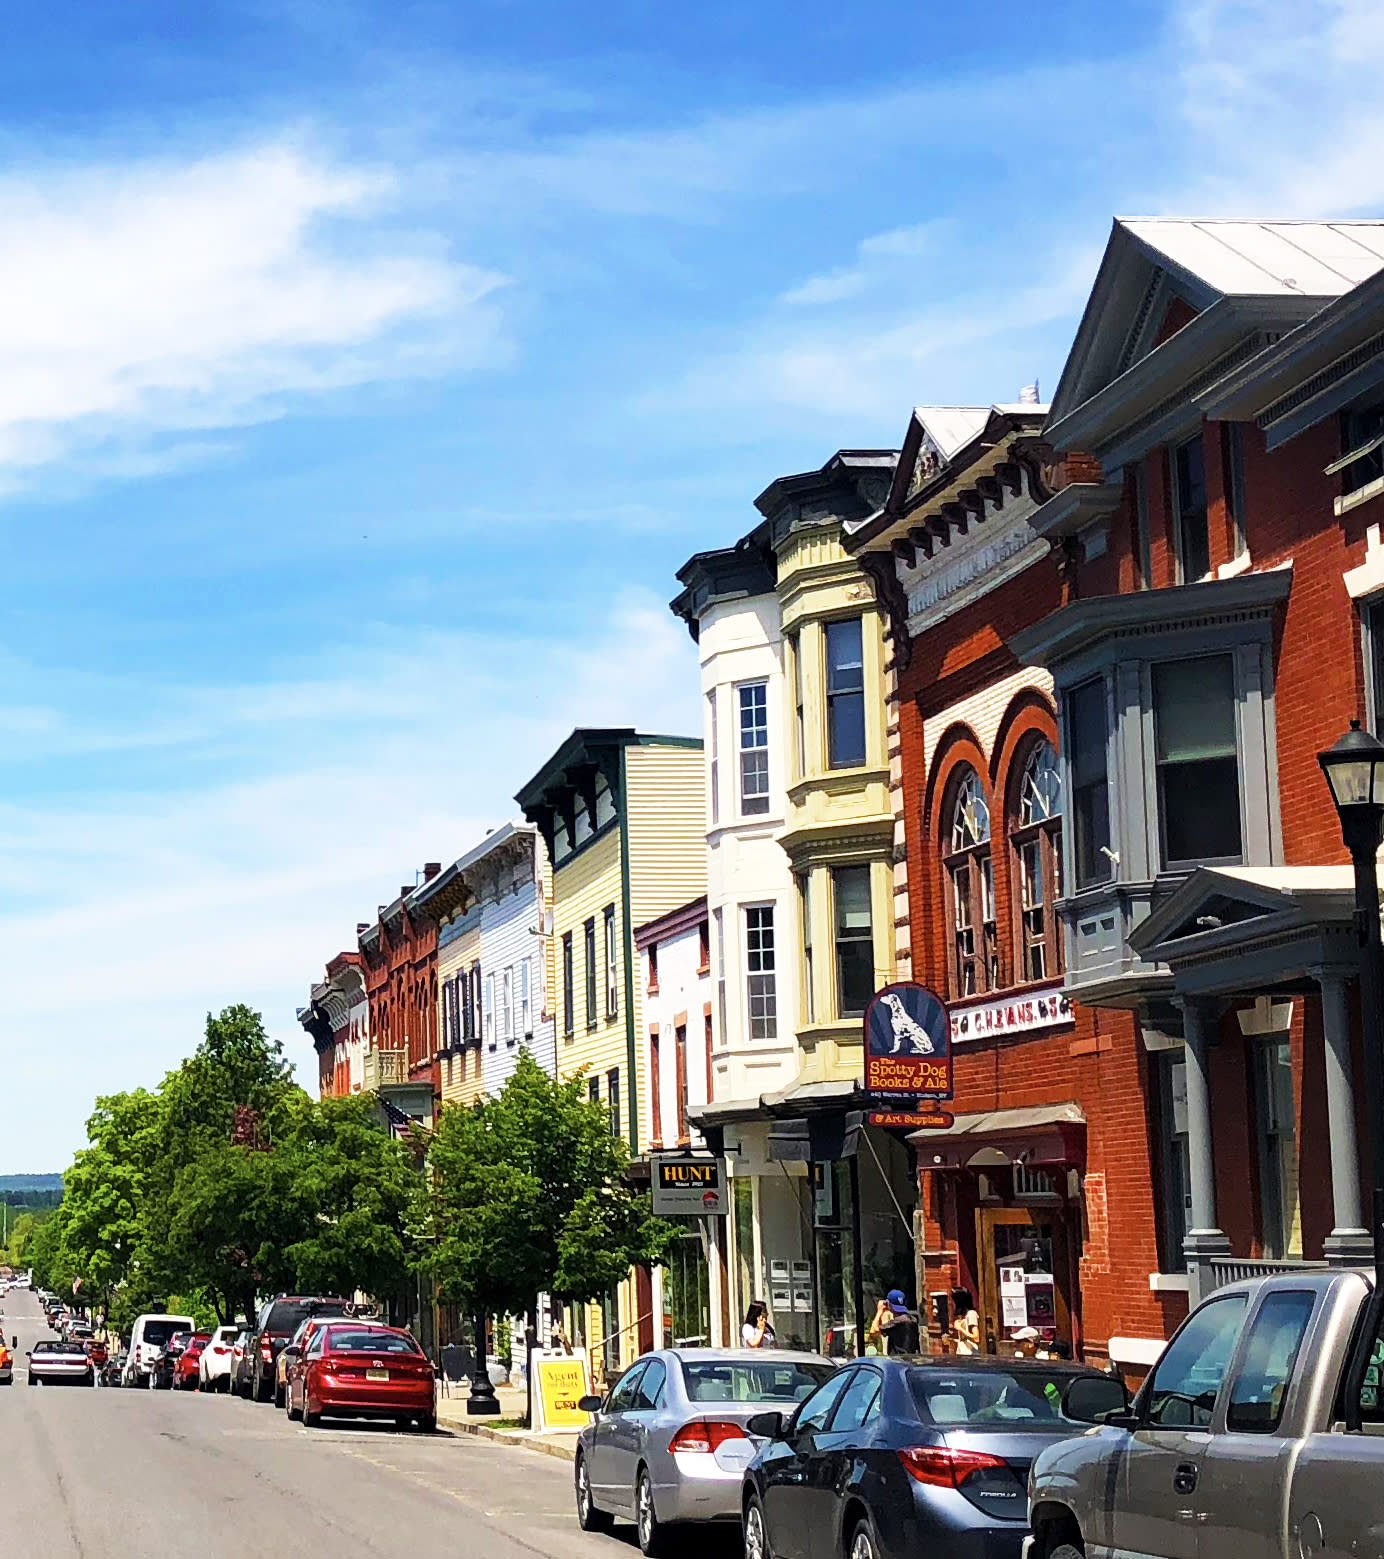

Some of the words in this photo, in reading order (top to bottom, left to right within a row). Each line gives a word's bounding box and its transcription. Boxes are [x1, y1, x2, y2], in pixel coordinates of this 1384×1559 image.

[869, 1061, 916, 1078] Spotty
[919, 1062, 947, 1079] Dog
[869, 1075, 910, 1088] Books
[912, 1077, 924, 1088] &
[925, 1077, 948, 1089] Ale
[884, 1114, 903, 1123] Art
[904, 1114, 945, 1125] Supplies
[663, 1166, 712, 1181] HUNT
